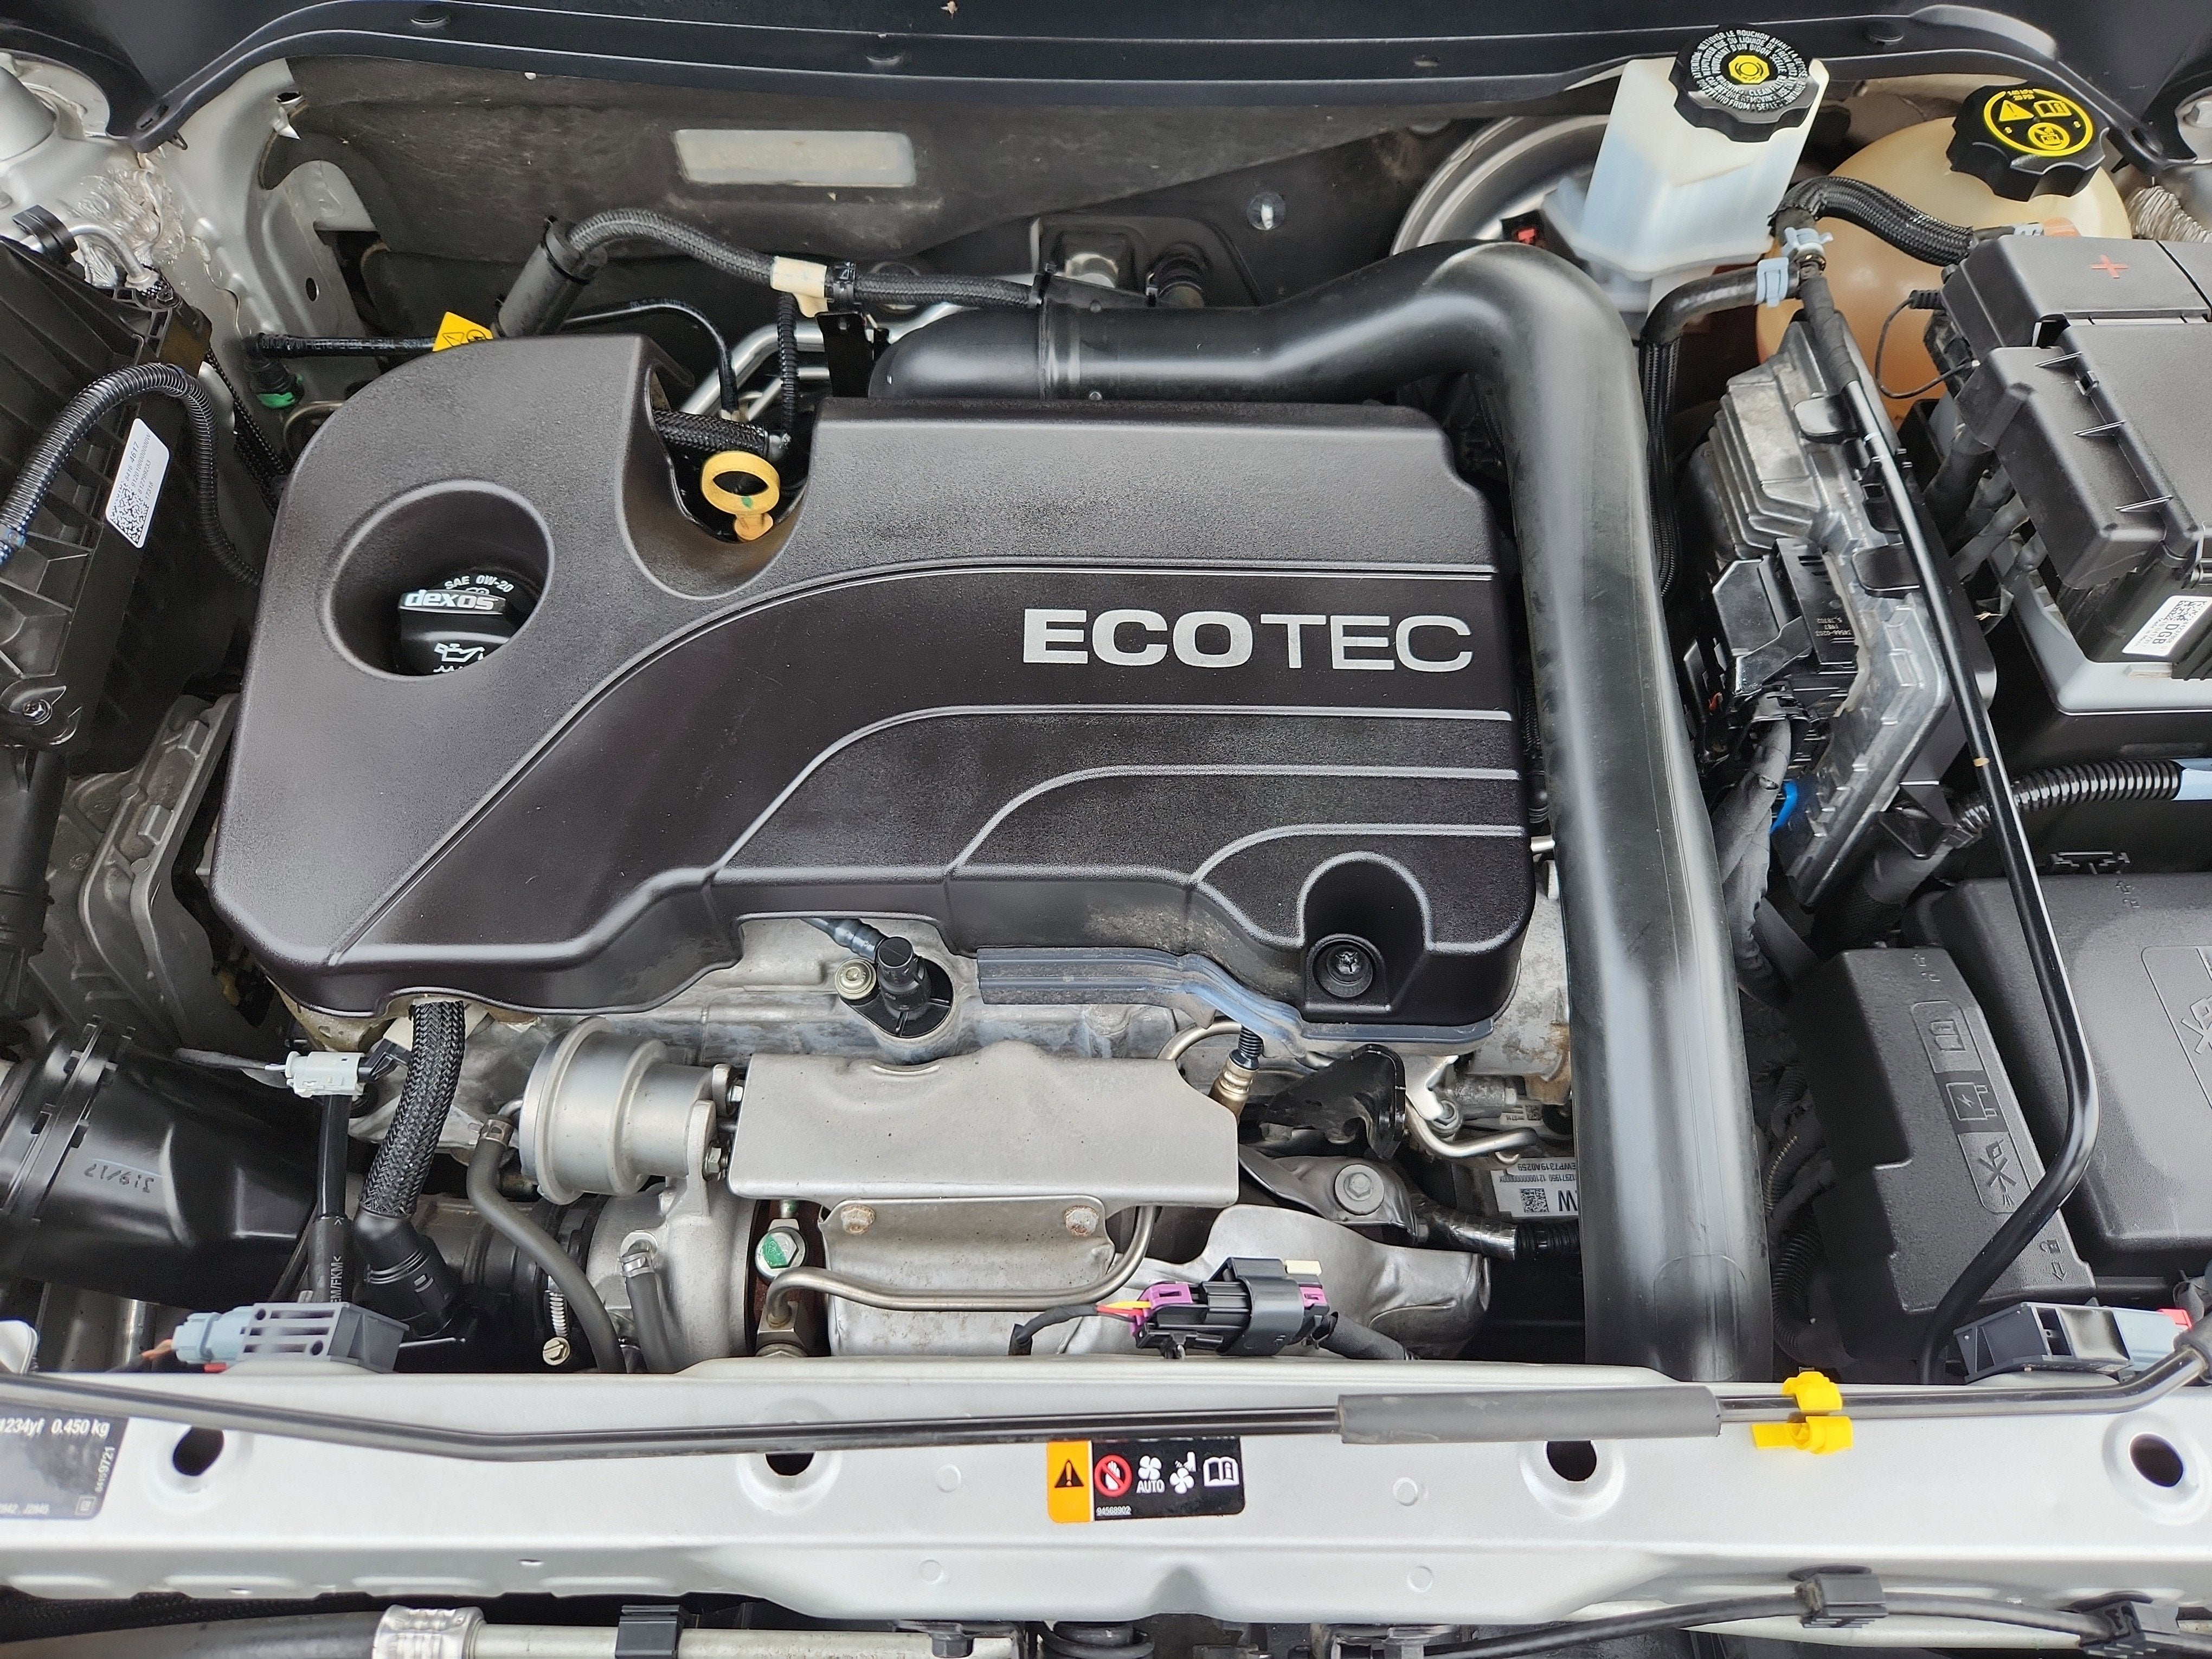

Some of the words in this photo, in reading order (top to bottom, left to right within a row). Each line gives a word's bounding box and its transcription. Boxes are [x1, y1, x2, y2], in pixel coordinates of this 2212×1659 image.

[1737, 29, 1770, 41] BOUCHON
[1769, 37, 1791, 51] AVANT
[1787, 50, 1799, 59] LA
[1739, 36, 1766, 47] LIQUIDE
[1749, 44, 1772, 57] BIDON
[1748, 86, 1773, 96] CLEAN
[1728, 99, 1750, 110] FROM
[129, 441, 139, 463] 4617
[445, 576, 470, 589] SAE
[475, 575, 515, 593] 0W-20
[404, 589, 494, 610] dexos
[1023, 608, 1473, 672] ECOTEC
[2152, 624, 2180, 644] DGB
[51, 1418, 91, 1435] 0.450
[91, 1418, 111, 1438] kg
[1136, 1480, 1165, 1493] AUTO
[1096, 1505, 1132, 1516] 94568902
